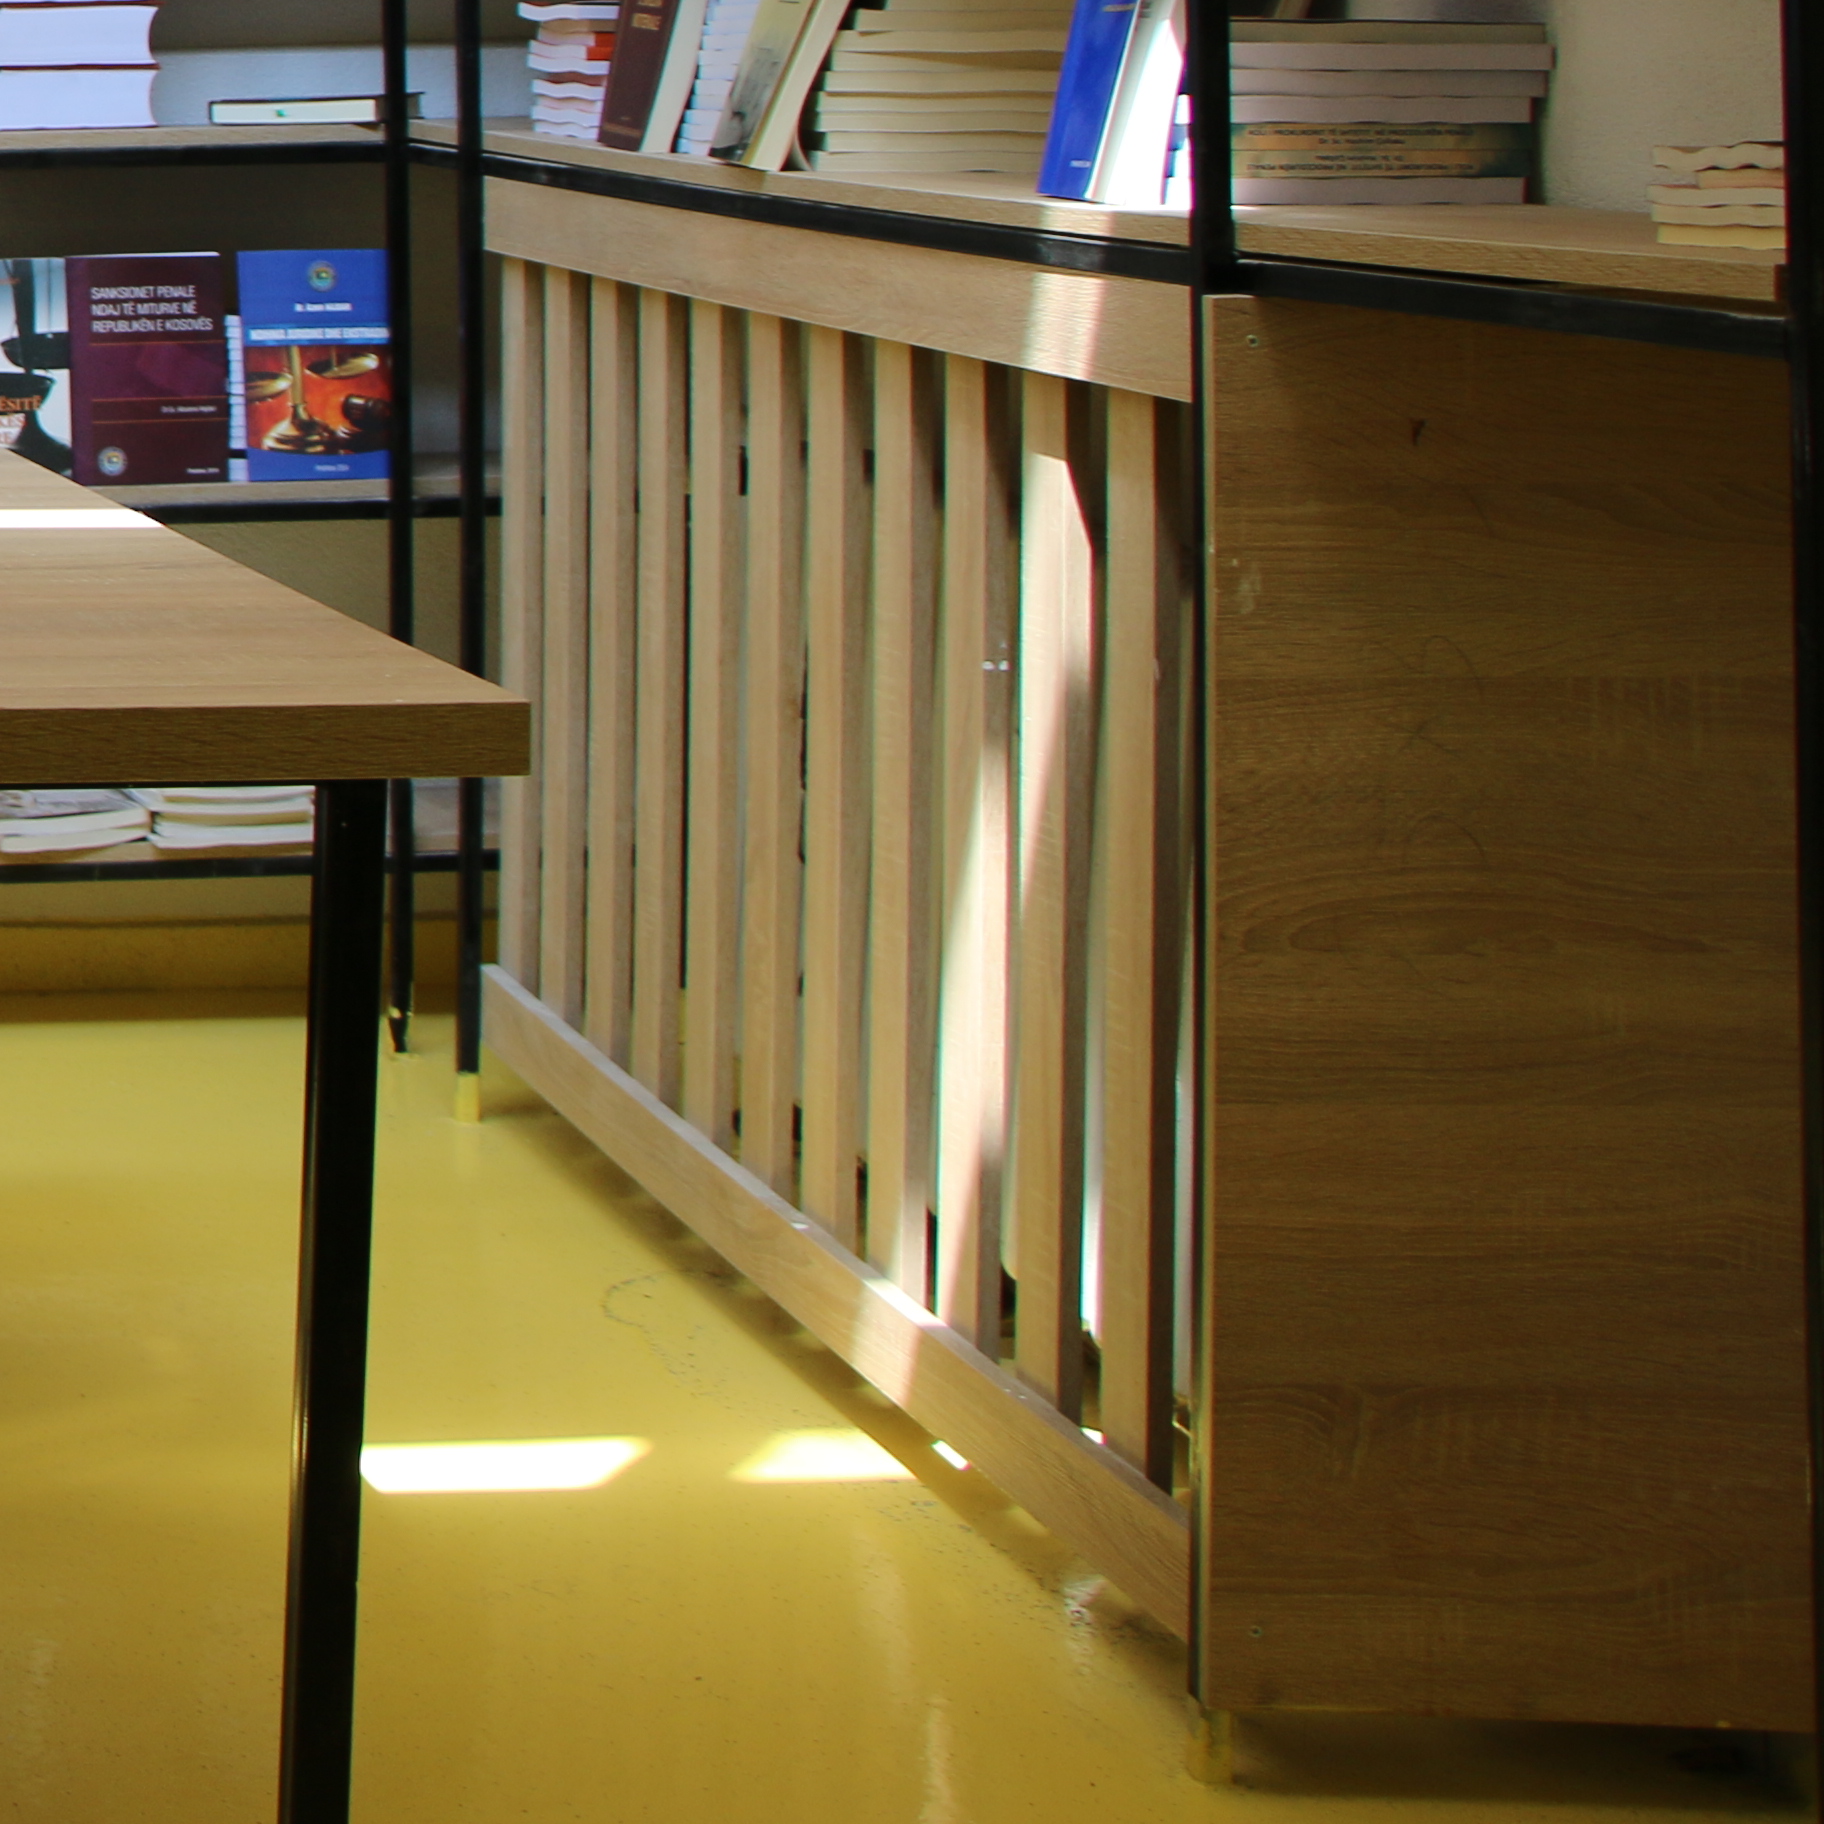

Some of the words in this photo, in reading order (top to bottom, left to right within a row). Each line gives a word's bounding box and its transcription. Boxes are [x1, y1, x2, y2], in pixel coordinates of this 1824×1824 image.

[91, 286, 153, 301] SANKSIONET
[157, 286, 196, 301] PENALE
[91, 302, 120, 316] NDAJ
[123, 302, 136, 316] TË
[183, 302, 196, 316] NË
[92, 317, 156, 333] REPUBLIKËN
[166, 317, 213, 333] KOSOVËS
